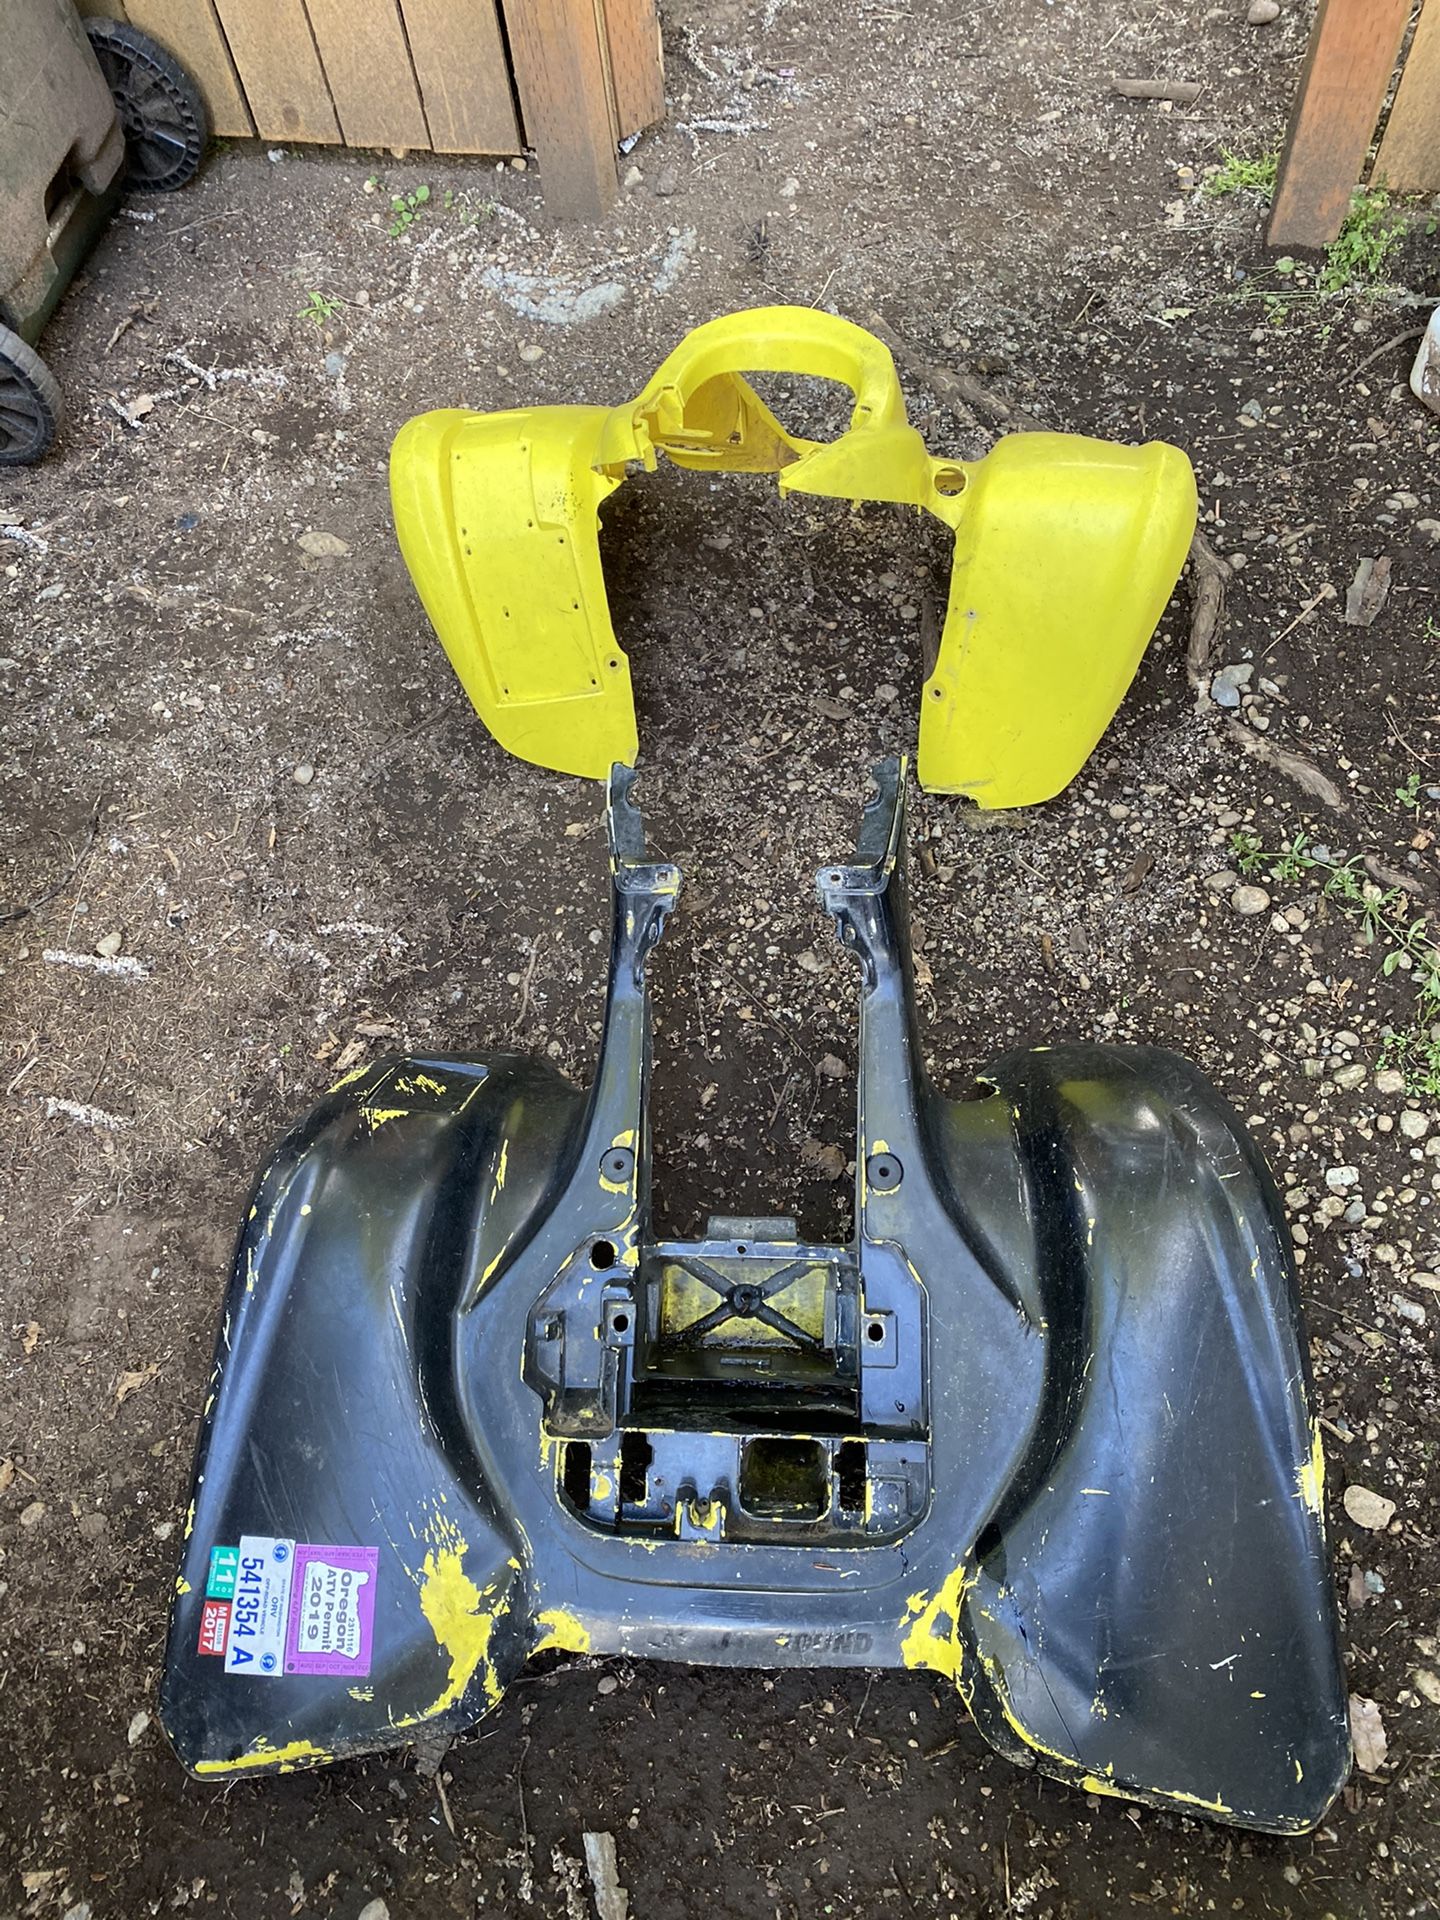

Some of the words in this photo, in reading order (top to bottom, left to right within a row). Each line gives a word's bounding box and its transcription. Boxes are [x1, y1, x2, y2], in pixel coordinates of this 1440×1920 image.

[216, 1552, 237, 1583] 11
[326, 1569, 337, 1599] ATV
[233, 1558, 264, 1638] 541354
[262, 1578, 271, 1609] OFF-ROAD
[270, 1596, 279, 1618] ORV
[307, 1577, 323, 1640] 2019
[336, 1571, 352, 1649] Oregon
[203, 1607, 217, 1650] 2017
[259, 1610, 267, 1635] VEHICLE
[322, 1602, 334, 1650] Permit
[346, 1617, 355, 1653] 2311116
[231, 1646, 254, 1666] A
